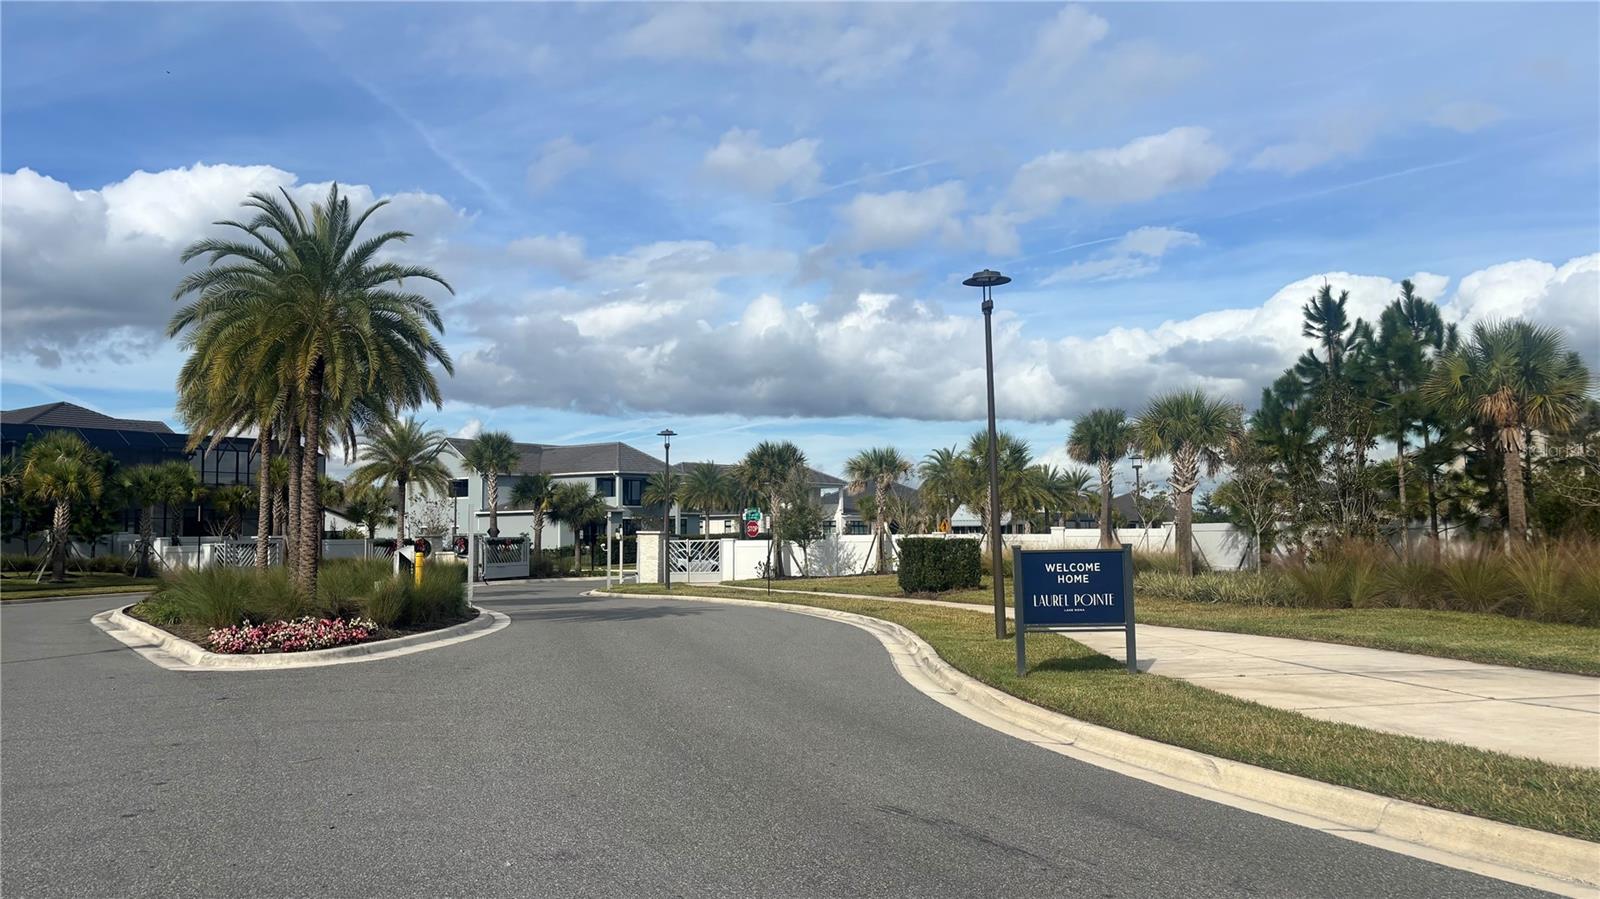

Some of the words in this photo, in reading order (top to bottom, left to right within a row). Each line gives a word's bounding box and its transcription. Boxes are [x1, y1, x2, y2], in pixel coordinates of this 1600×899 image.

[1044, 562, 1101, 572] WELCOME
[1057, 574, 1089, 583] HOME
[1033, 594, 1070, 607] LAUREL
[1074, 593, 1115, 607] POINTE
